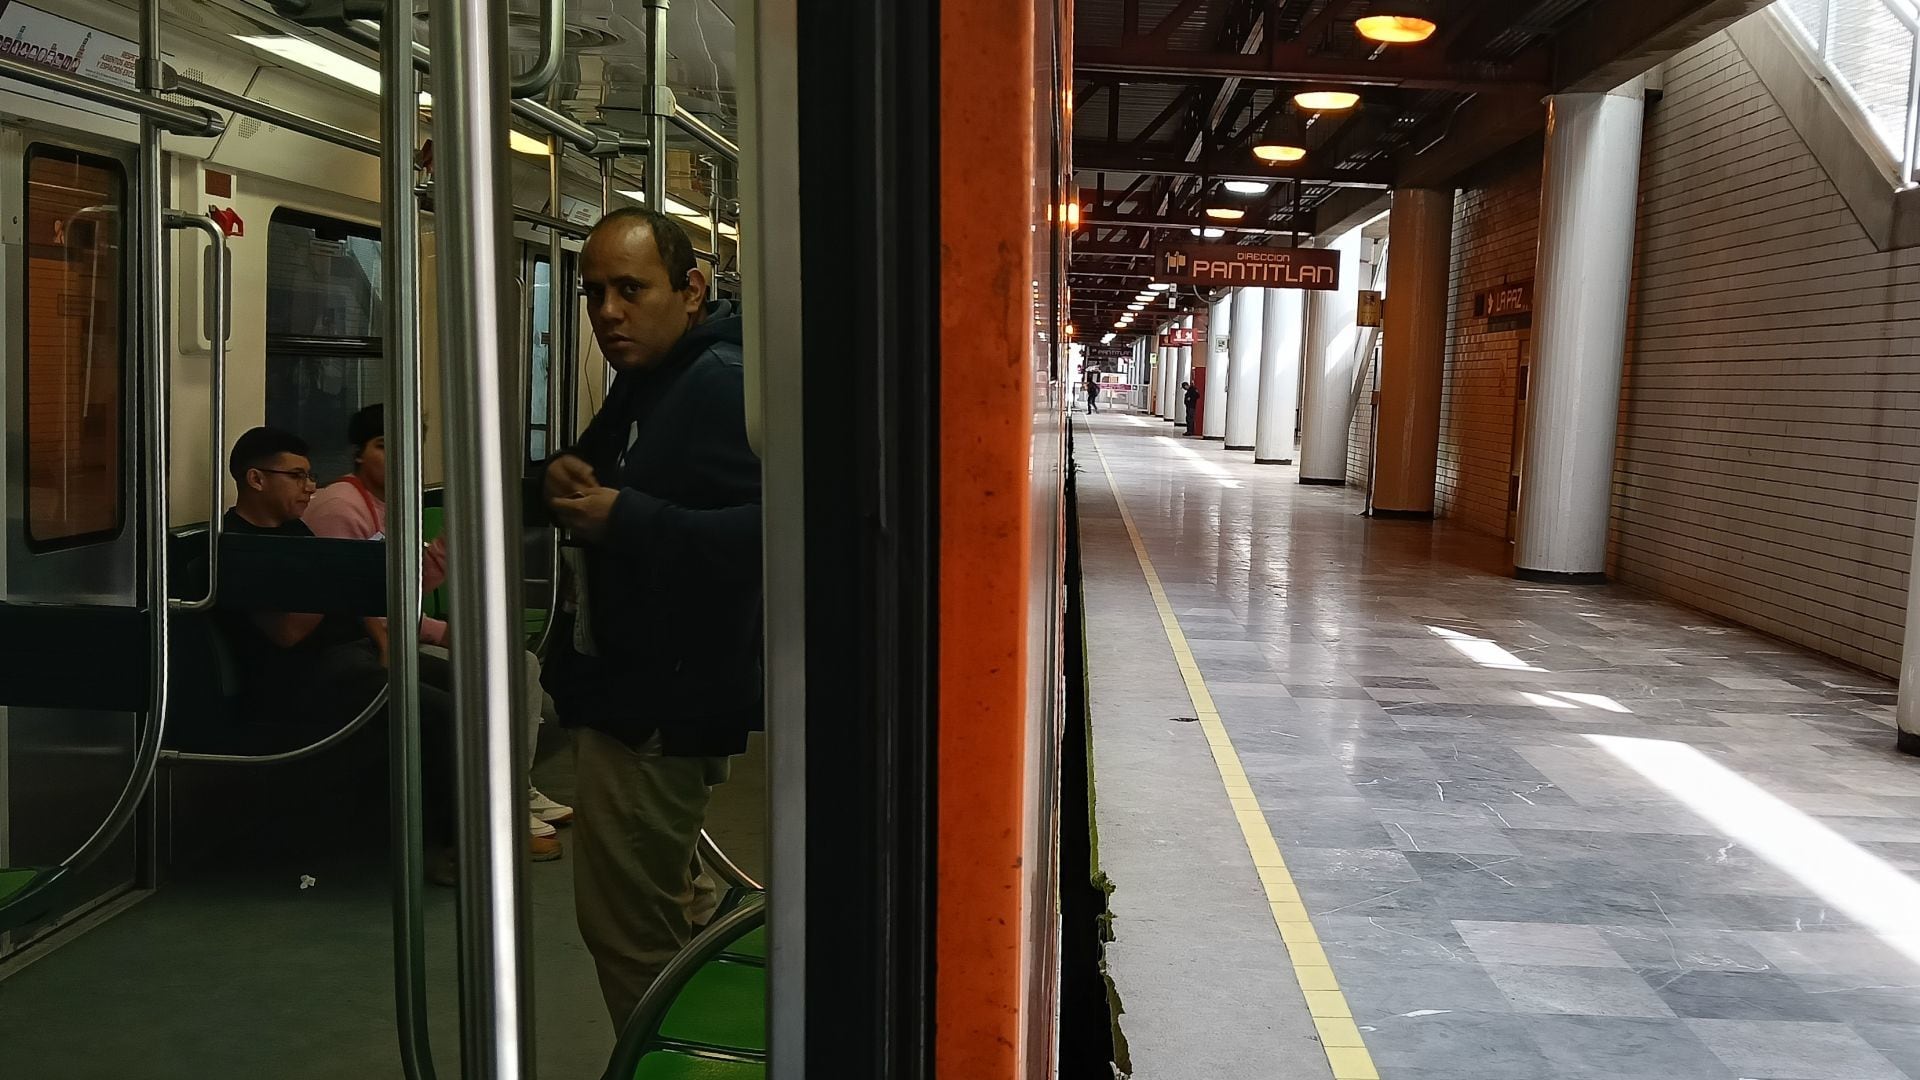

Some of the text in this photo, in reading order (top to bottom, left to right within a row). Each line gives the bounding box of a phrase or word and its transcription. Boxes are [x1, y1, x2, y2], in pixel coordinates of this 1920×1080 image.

[1237, 252, 1290, 262] DIRECCION
[1192, 260, 1334, 284] PANTITLAN
[1496, 287, 1523, 312] LA PAZ
